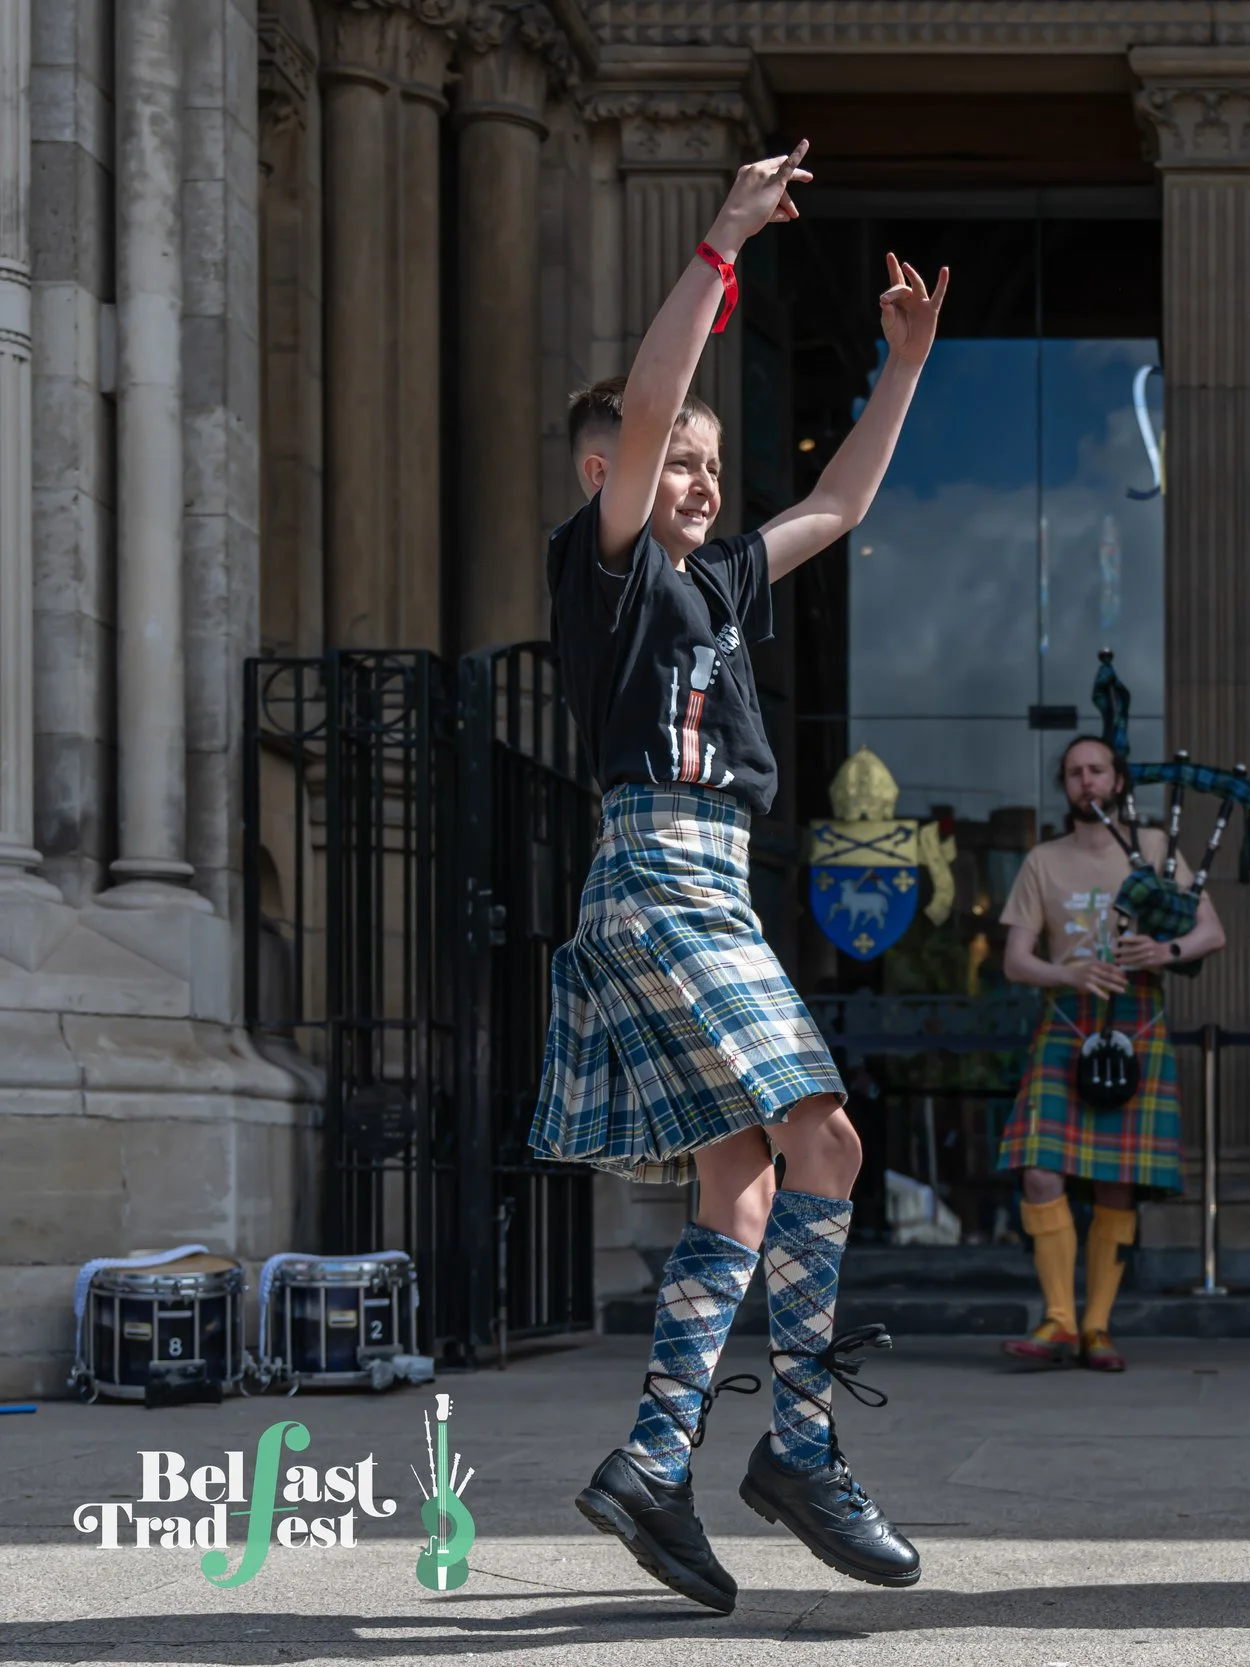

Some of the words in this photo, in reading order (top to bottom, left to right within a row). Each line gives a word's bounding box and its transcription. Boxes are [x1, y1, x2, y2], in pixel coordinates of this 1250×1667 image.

[720, 626, 740, 656] RAD
[370, 1319, 383, 1340] 2
[169, 1337, 182, 1357] 8
